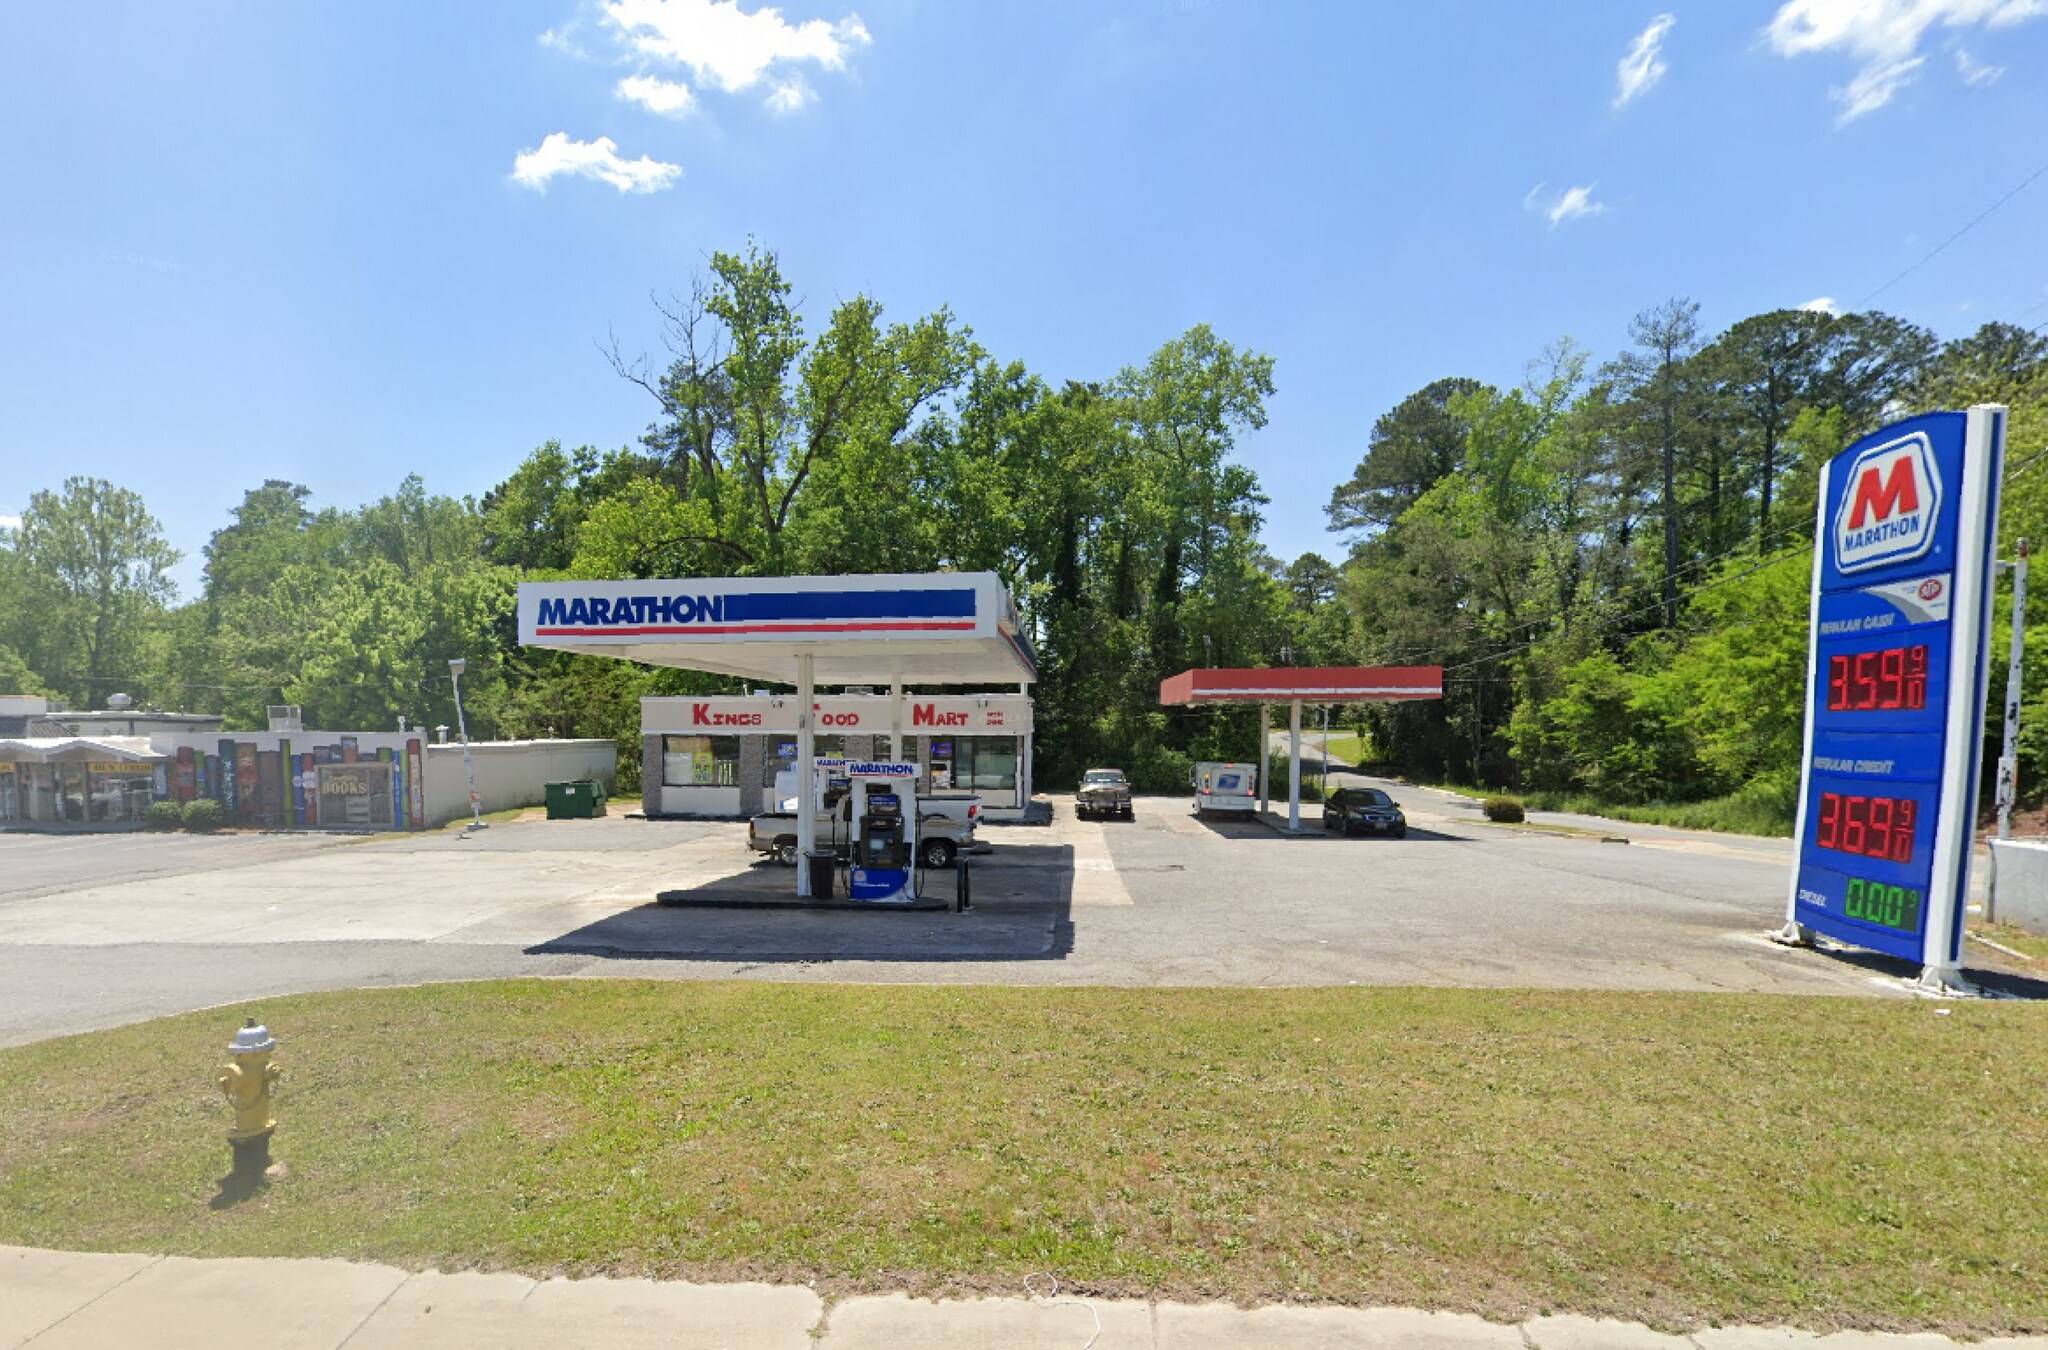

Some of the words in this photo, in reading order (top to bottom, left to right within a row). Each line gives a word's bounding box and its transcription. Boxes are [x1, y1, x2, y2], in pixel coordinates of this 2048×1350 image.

[1847, 455, 1919, 531] M
[1844, 513, 1920, 552] MARATHON
[537, 595, 723, 625] MARATHON
[1820, 618, 1862, 635] REGULAR
[813, 703, 859, 726] OOD
[850, 763, 913, 775] MARATHON
[1814, 756, 1853, 772] REGULAR
[1854, 760, 1895, 774] CREDIT
[321, 782, 367, 794] BOOKS
